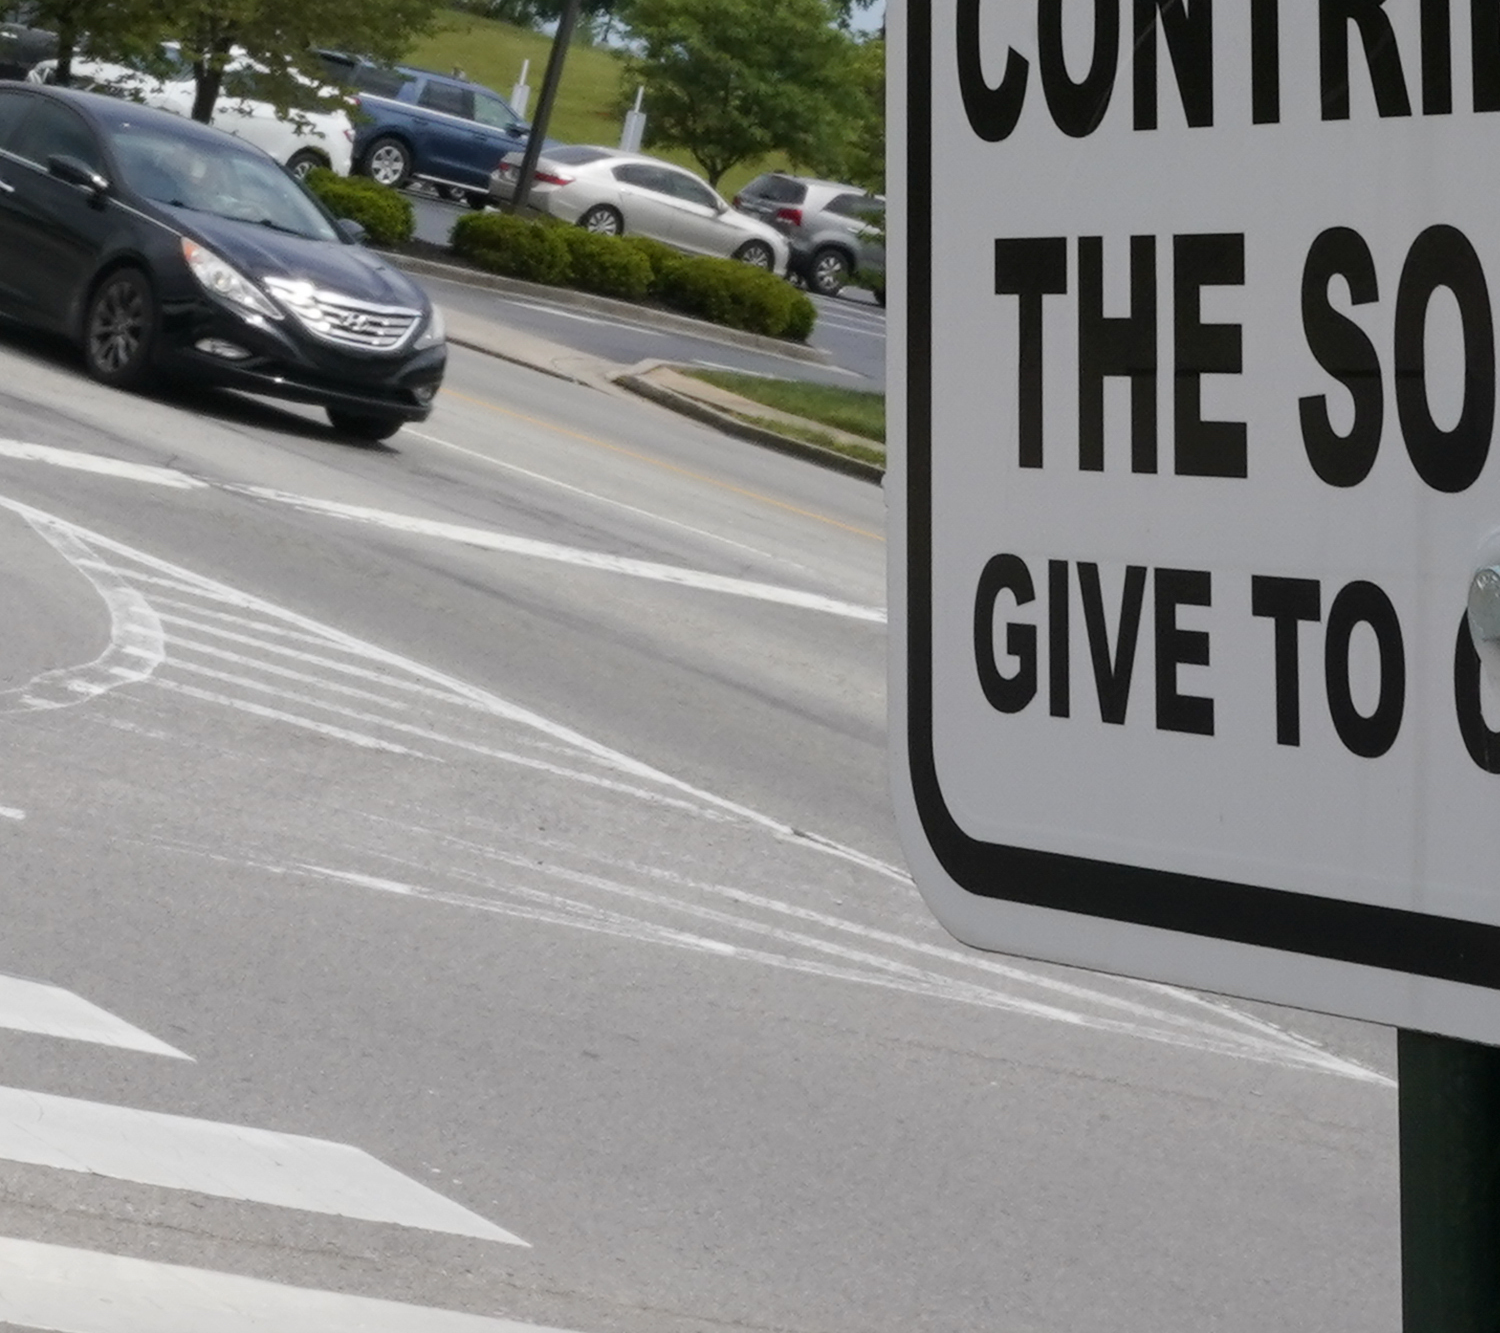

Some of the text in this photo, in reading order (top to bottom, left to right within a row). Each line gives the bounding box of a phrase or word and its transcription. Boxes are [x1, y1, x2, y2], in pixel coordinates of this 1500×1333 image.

[994, 231, 1249, 480] THE
[972, 551, 1215, 738] GIVE
[1251, 572, 1408, 760] TO
